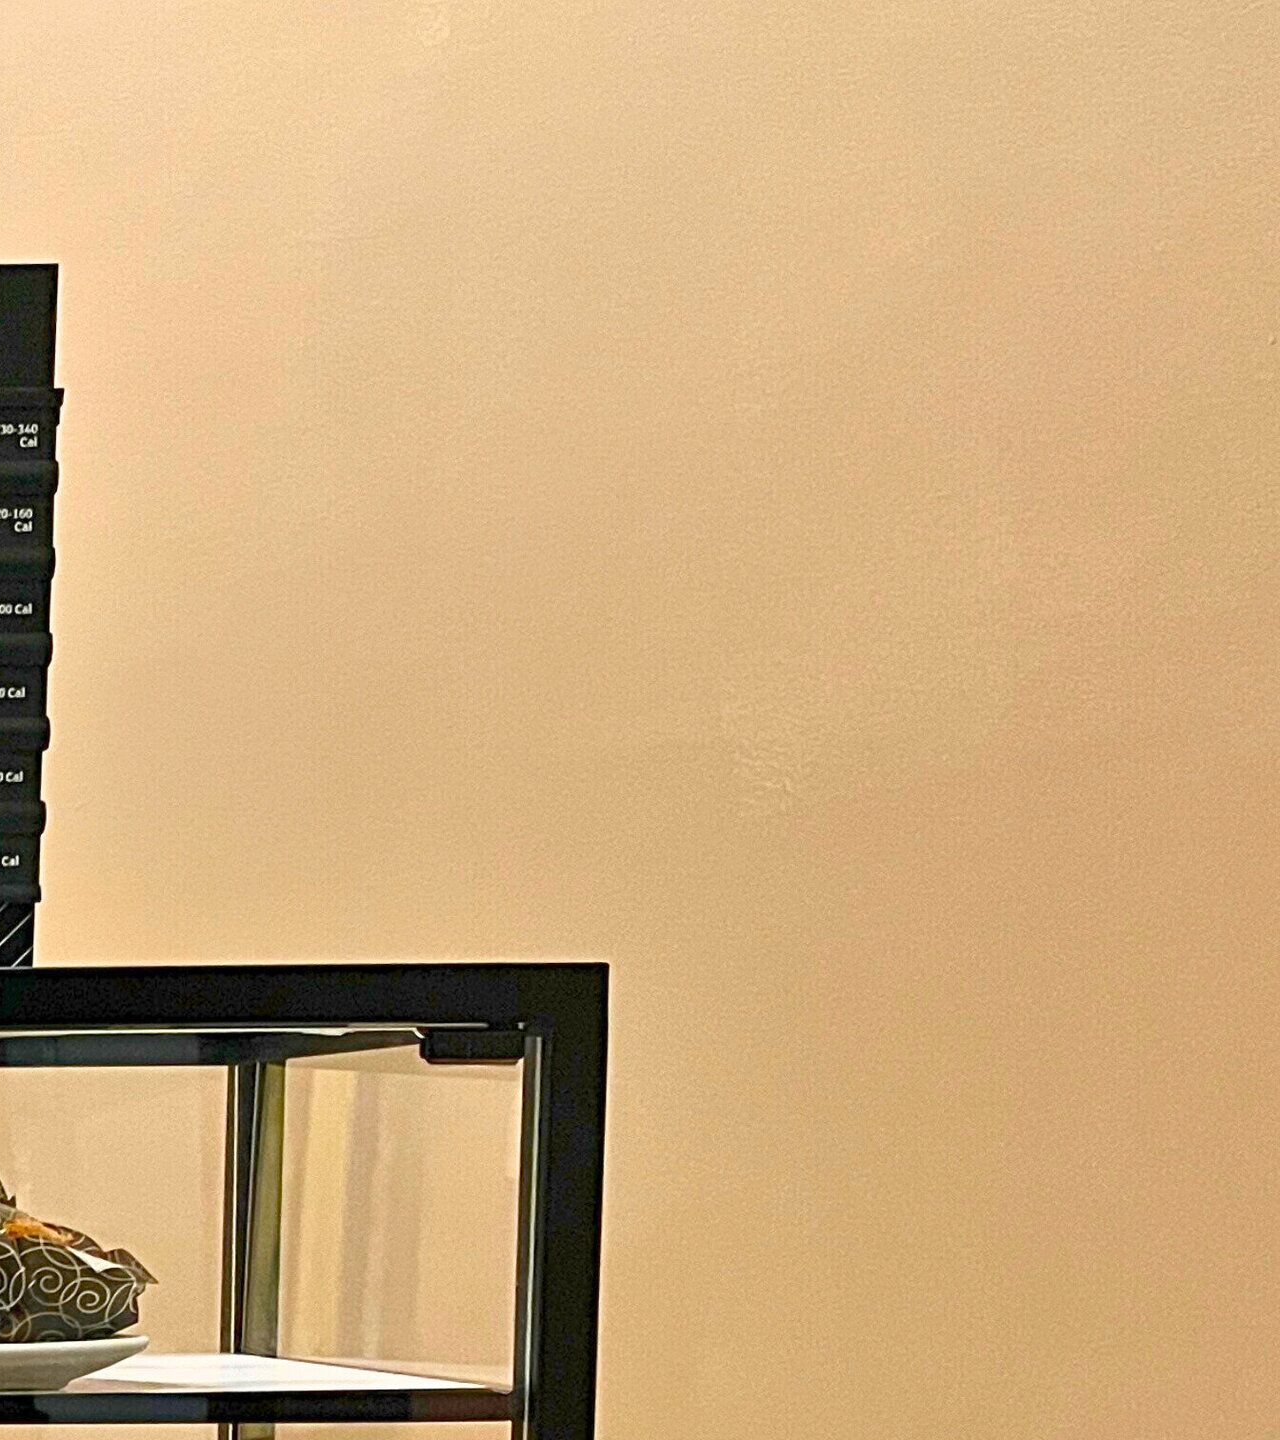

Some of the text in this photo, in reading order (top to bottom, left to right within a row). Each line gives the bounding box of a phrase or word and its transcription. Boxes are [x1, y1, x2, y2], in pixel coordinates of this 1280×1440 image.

[19, 436, 38, 448] Cal
[13, 520, 33, 532] Cal
[14, 603, 33, 615] Cal
[7, 687, 26, 698] Cal
[5, 770, 24, 782] Cal
[1, 855, 20, 867] Cal
